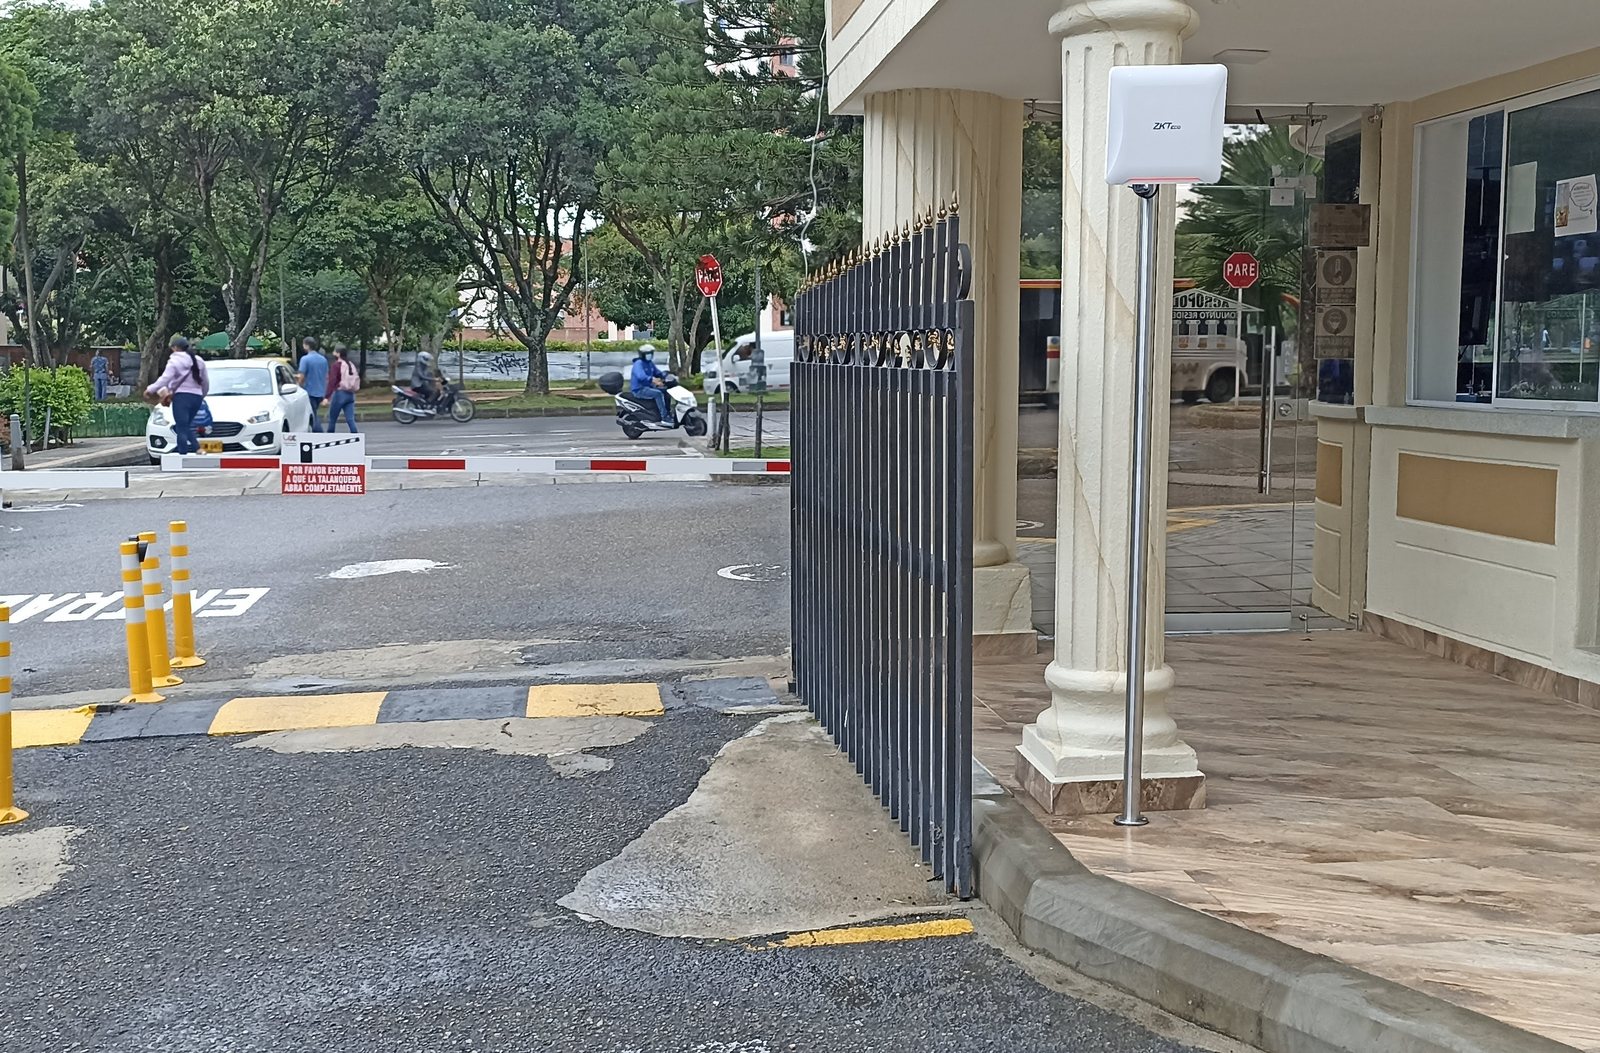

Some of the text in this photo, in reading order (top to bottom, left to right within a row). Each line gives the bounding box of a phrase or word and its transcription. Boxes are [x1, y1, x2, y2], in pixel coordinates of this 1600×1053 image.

[1227, 263, 1256, 276] PARE
[288, 466, 358, 474] POR FAVOR ESPERAR
[285, 475, 361, 483] A QUE LA TALANQUERA
[284, 484, 363, 493] ABRA COMPLETAMENTE
